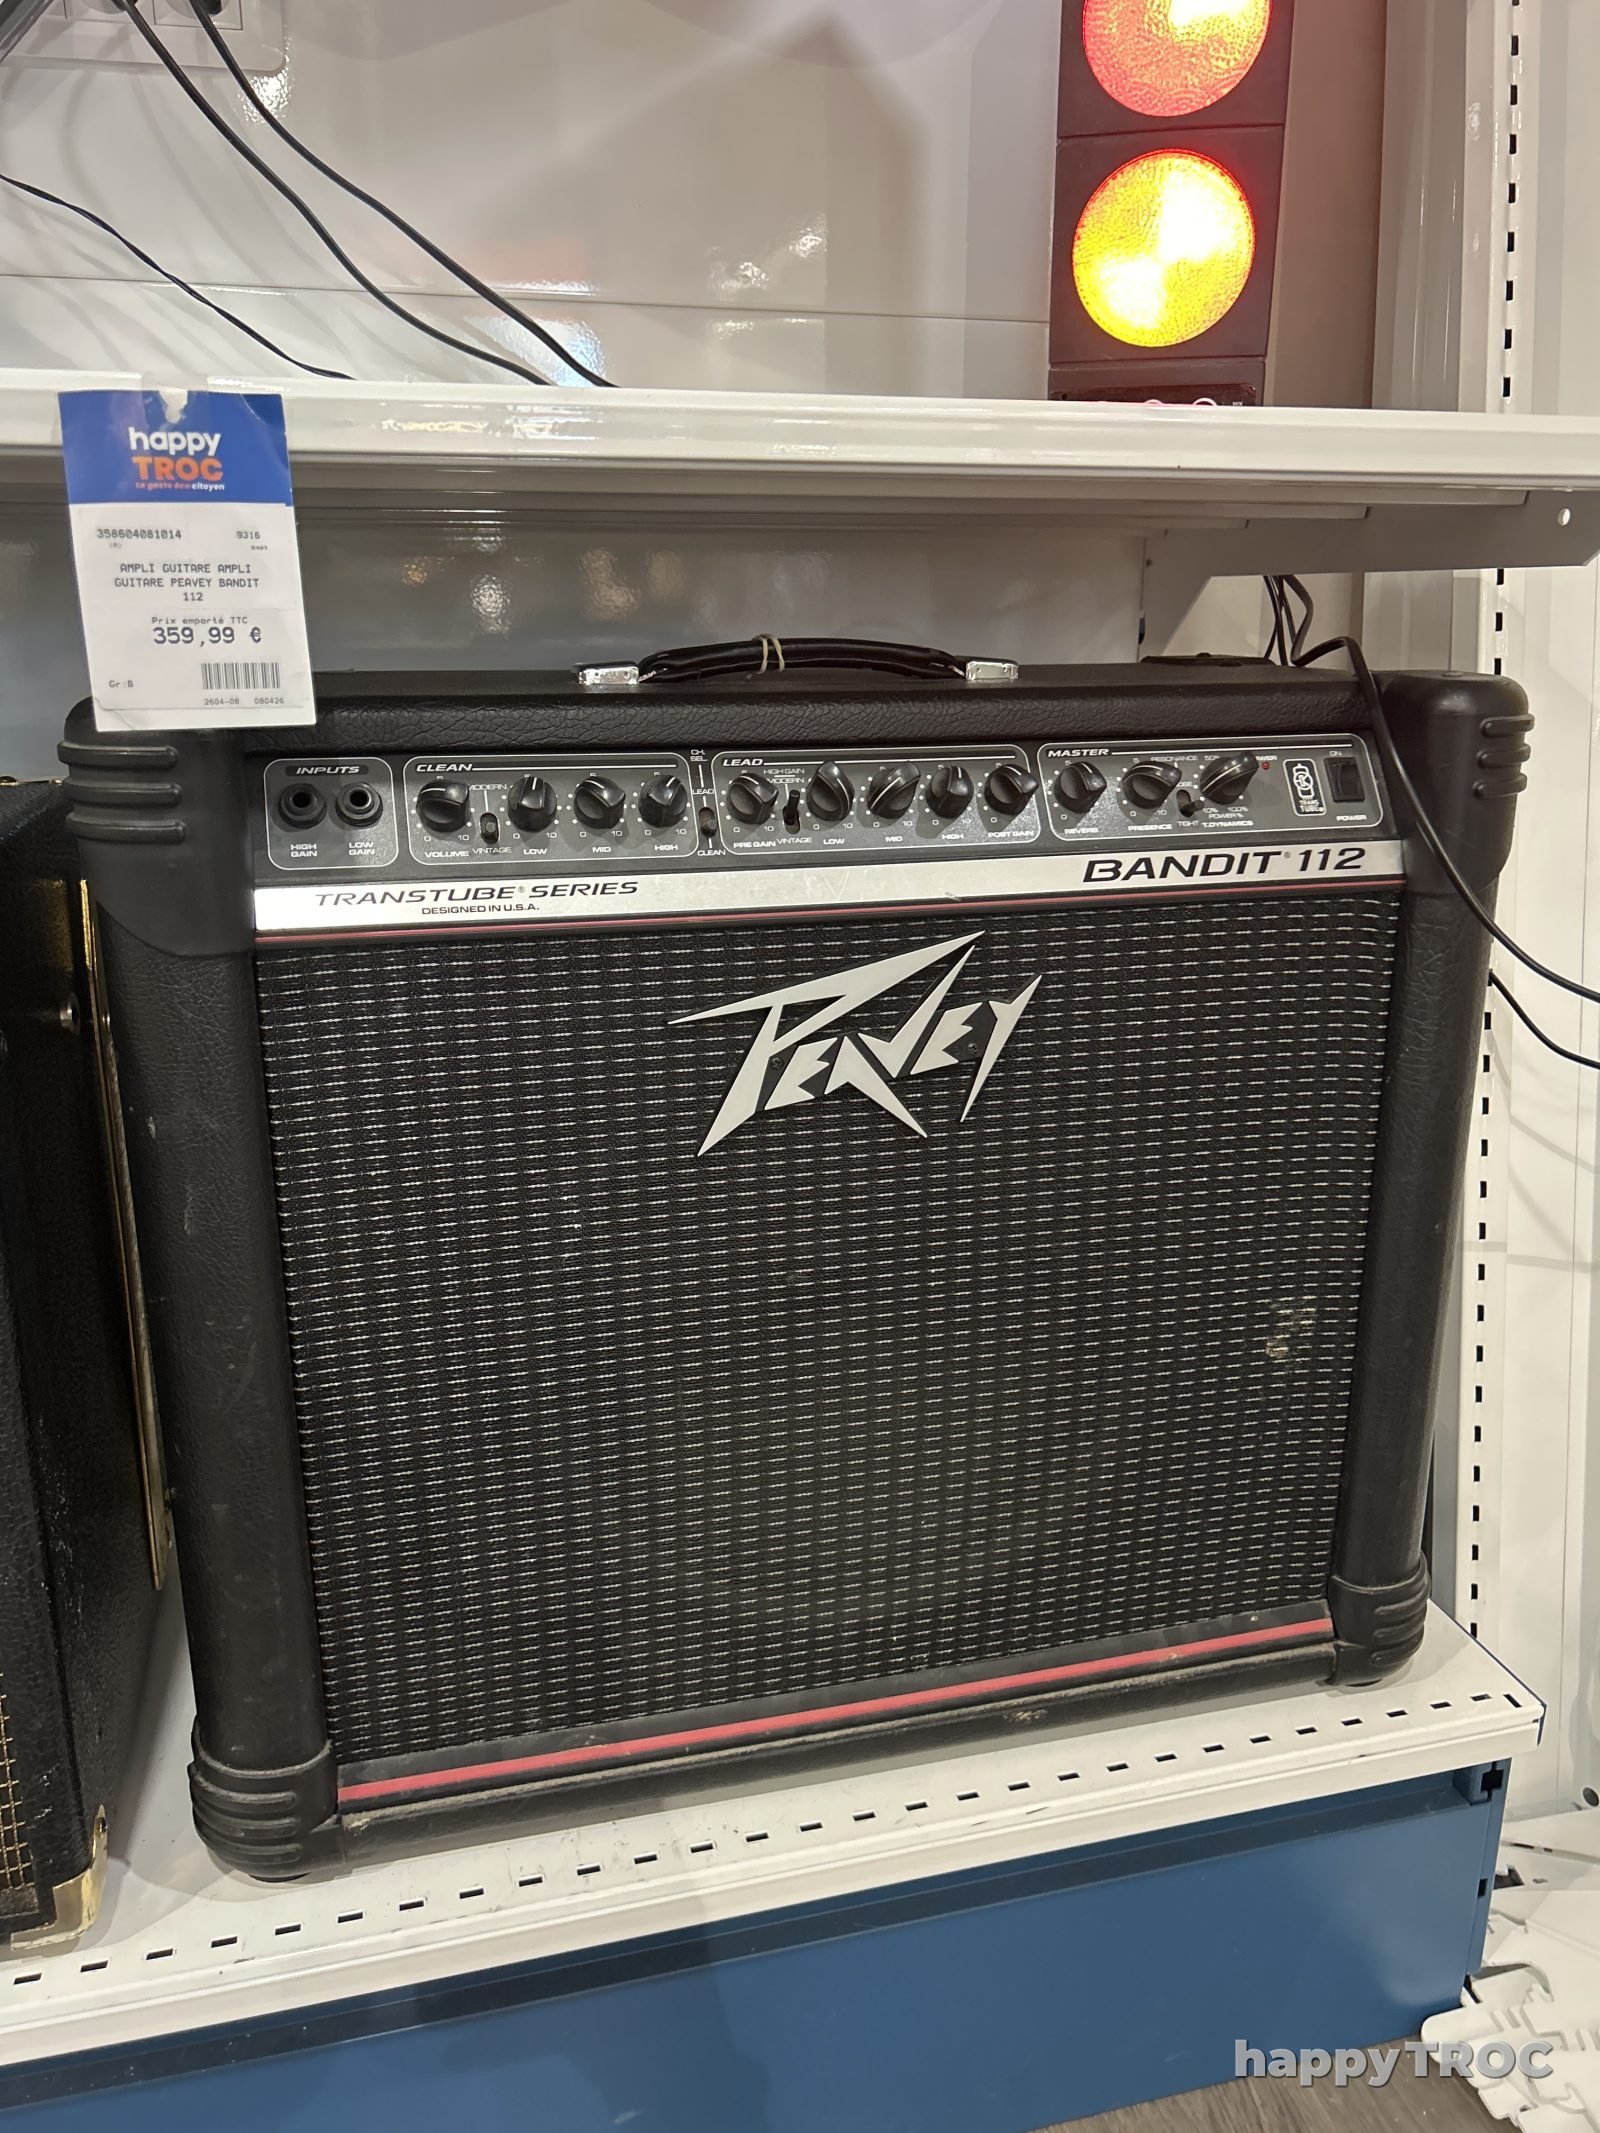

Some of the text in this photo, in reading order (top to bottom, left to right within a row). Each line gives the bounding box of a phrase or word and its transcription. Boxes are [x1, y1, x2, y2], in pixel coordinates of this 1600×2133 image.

[128, 426, 221, 456] happy
[132, 456, 223, 482] TROC
[97, 529, 182, 540] 358604081014
[120, 564, 251, 574] AMPLI GUITARE AMPLI
[114, 578, 259, 588] GUITARE PEAVEY BANDIT
[183, 592, 203, 602] 112
[182, 617, 224, 625] emporté
[249, 626, 262, 643] €
[1048, 749, 1109, 757] MASTER
[723, 758, 763, 766] LEAD
[296, 766, 360, 775] INPUTS
[416, 763, 473, 772] CLEAN
[512, 832, 521, 840] 0
[290, 843, 317, 851] HIGH
[349, 848, 375, 856] GAIN
[290, 850, 318, 858] GAIN
[1299, 848, 1366, 872] 112
[529, 881, 638, 898] SERIES
[421, 906, 486, 915] DESIGNED
[503, 903, 540, 912] U.S.A.
